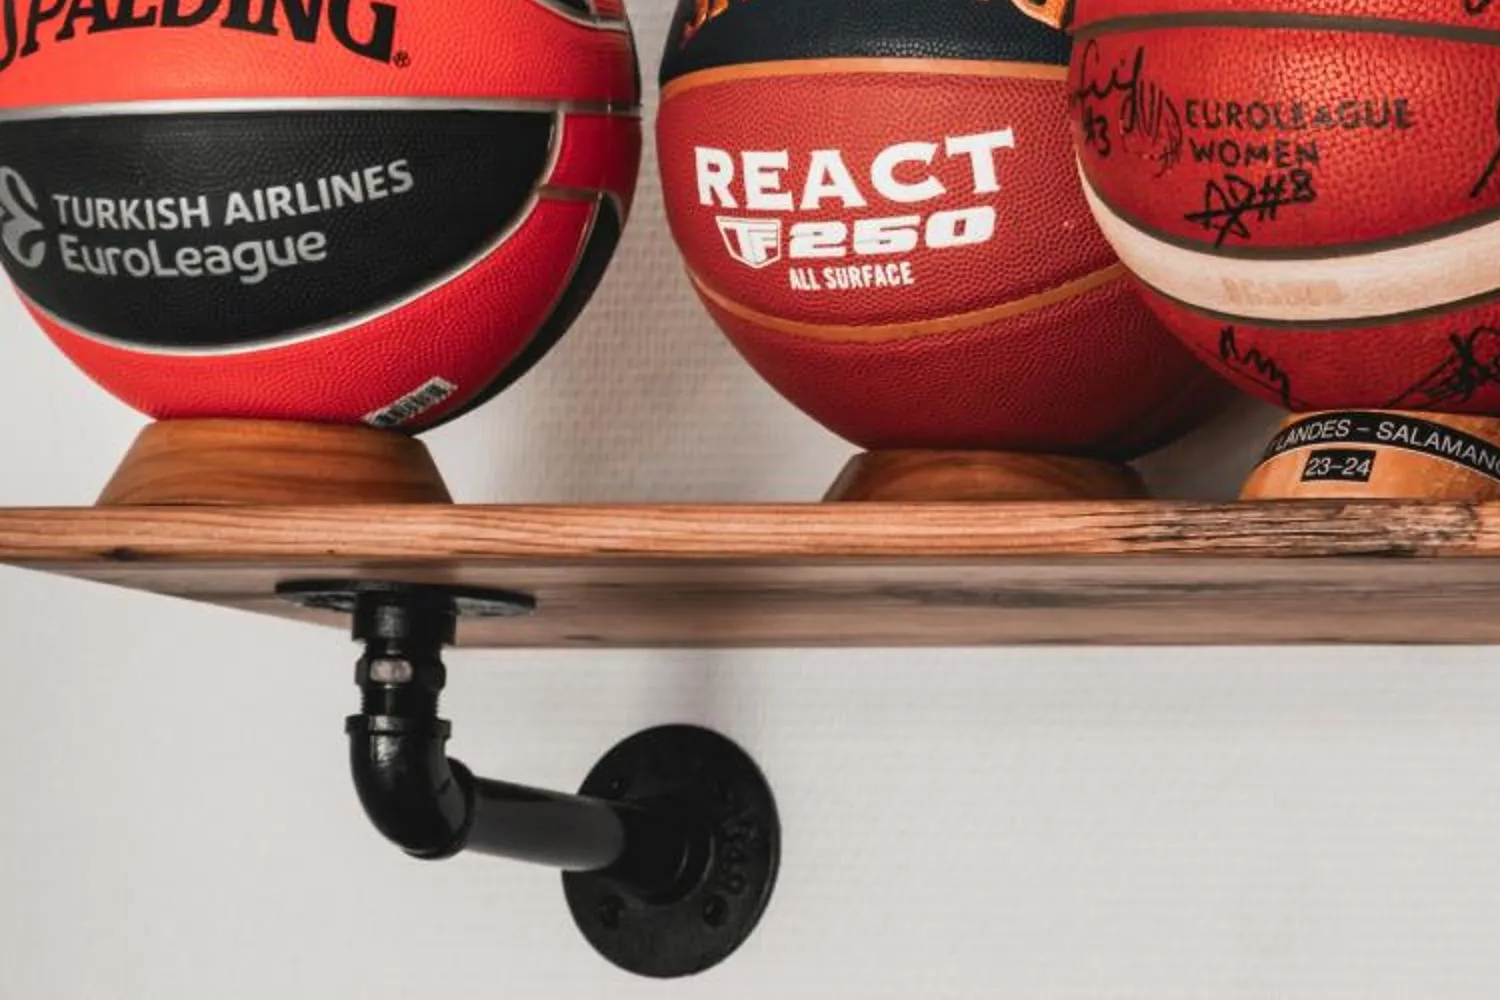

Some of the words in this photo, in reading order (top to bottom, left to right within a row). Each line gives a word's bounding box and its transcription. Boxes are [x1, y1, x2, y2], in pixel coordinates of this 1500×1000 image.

[1185, 98, 1413, 131] EUROLEAGUE
[694, 127, 1016, 212] REACT
[1190, 138, 1320, 168] WOMEN
[52, 194, 211, 231] TURKISH
[224, 159, 414, 226] AIRLINES
[788, 205, 997, 259] 250
[57, 230, 328, 285] EuroLeague
[789, 265, 821, 292] ALL
[824, 261, 915, 290] SURFACE
[1274, 419, 1352, 451] LANDES
[1305, 456, 1371, 477] 23-24
